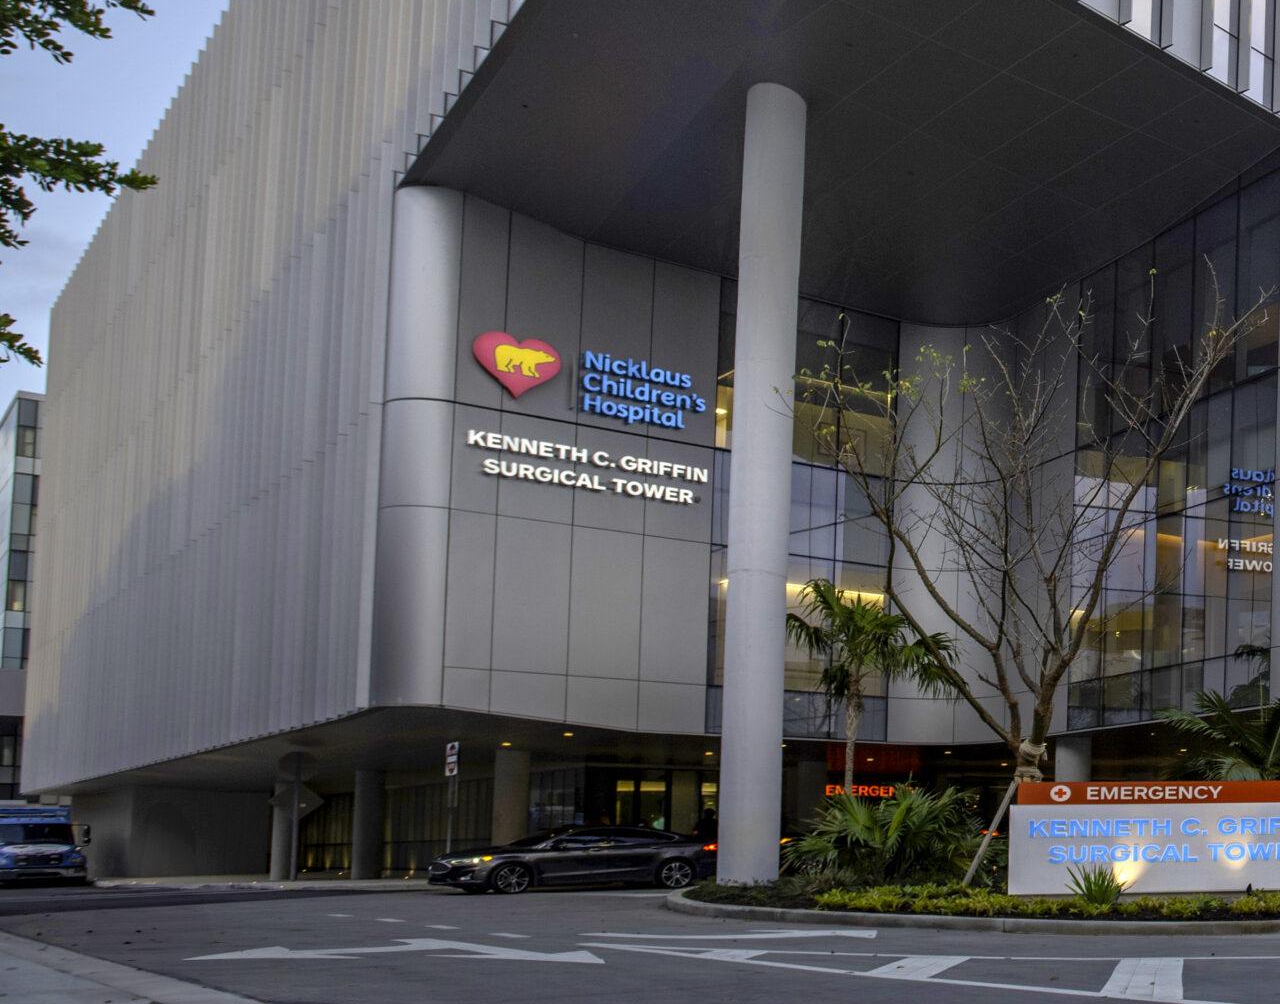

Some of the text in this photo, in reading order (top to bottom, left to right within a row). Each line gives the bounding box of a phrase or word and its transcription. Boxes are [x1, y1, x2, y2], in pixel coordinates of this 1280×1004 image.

[584, 350, 692, 388] Nicklaus
[583, 372, 707, 412] Children's
[583, 393, 686, 429] Hospital
[467, 429, 708, 483] KENNETH C. GRIFFIN
[483, 458, 694, 504] SURGICAL TOWER
[1086, 785, 1223, 801] EMERGENCY
[1028, 818, 1172, 839] KENNETH
[1180, 817, 1208, 837] C.
[1047, 843, 1199, 864] SURGICAL
